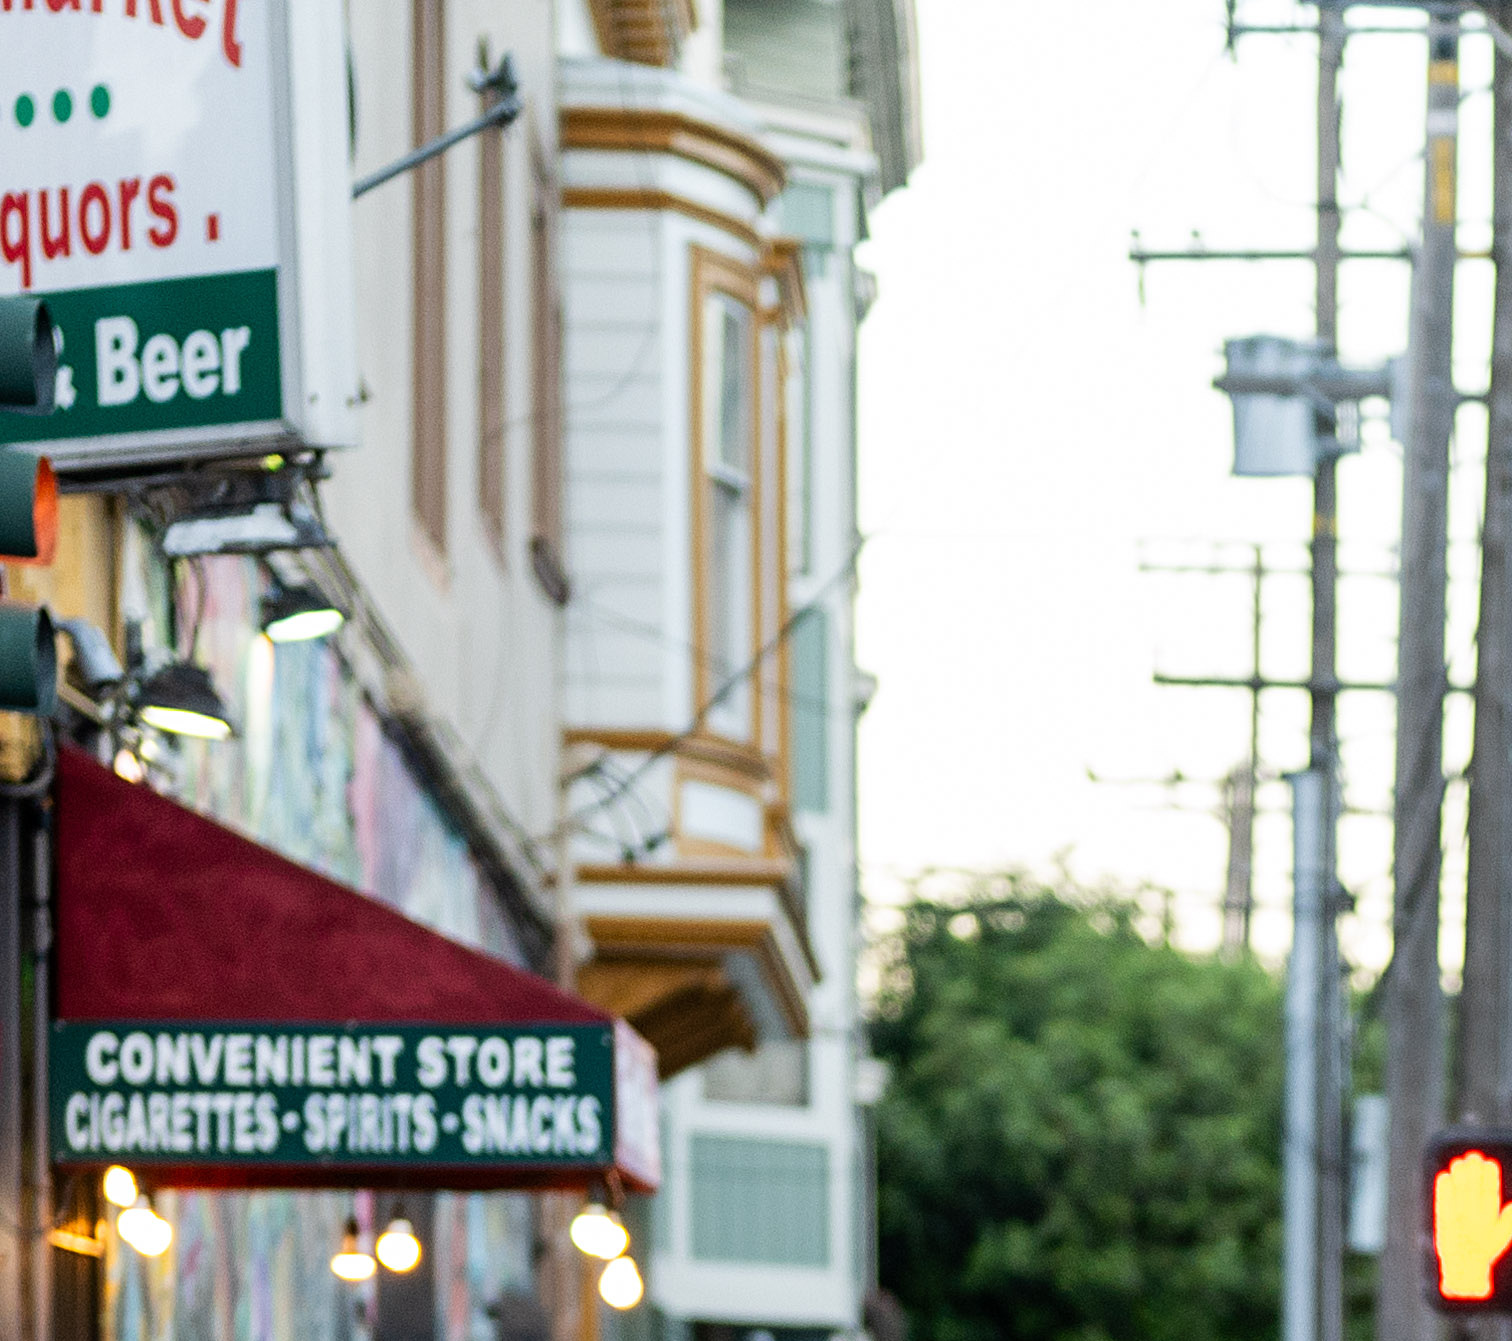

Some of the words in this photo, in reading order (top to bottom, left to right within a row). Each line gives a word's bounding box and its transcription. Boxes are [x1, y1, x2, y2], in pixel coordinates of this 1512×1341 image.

[94, 314, 250, 408] Beer
[86, 1031, 404, 1087] CONVENIENT
[415, 1036, 577, 1089] STORE
[64, 1092, 280, 1153] CIGARETTES
[304, 1094, 439, 1153] SPIRITS
[462, 1094, 602, 1154] SNACKS
